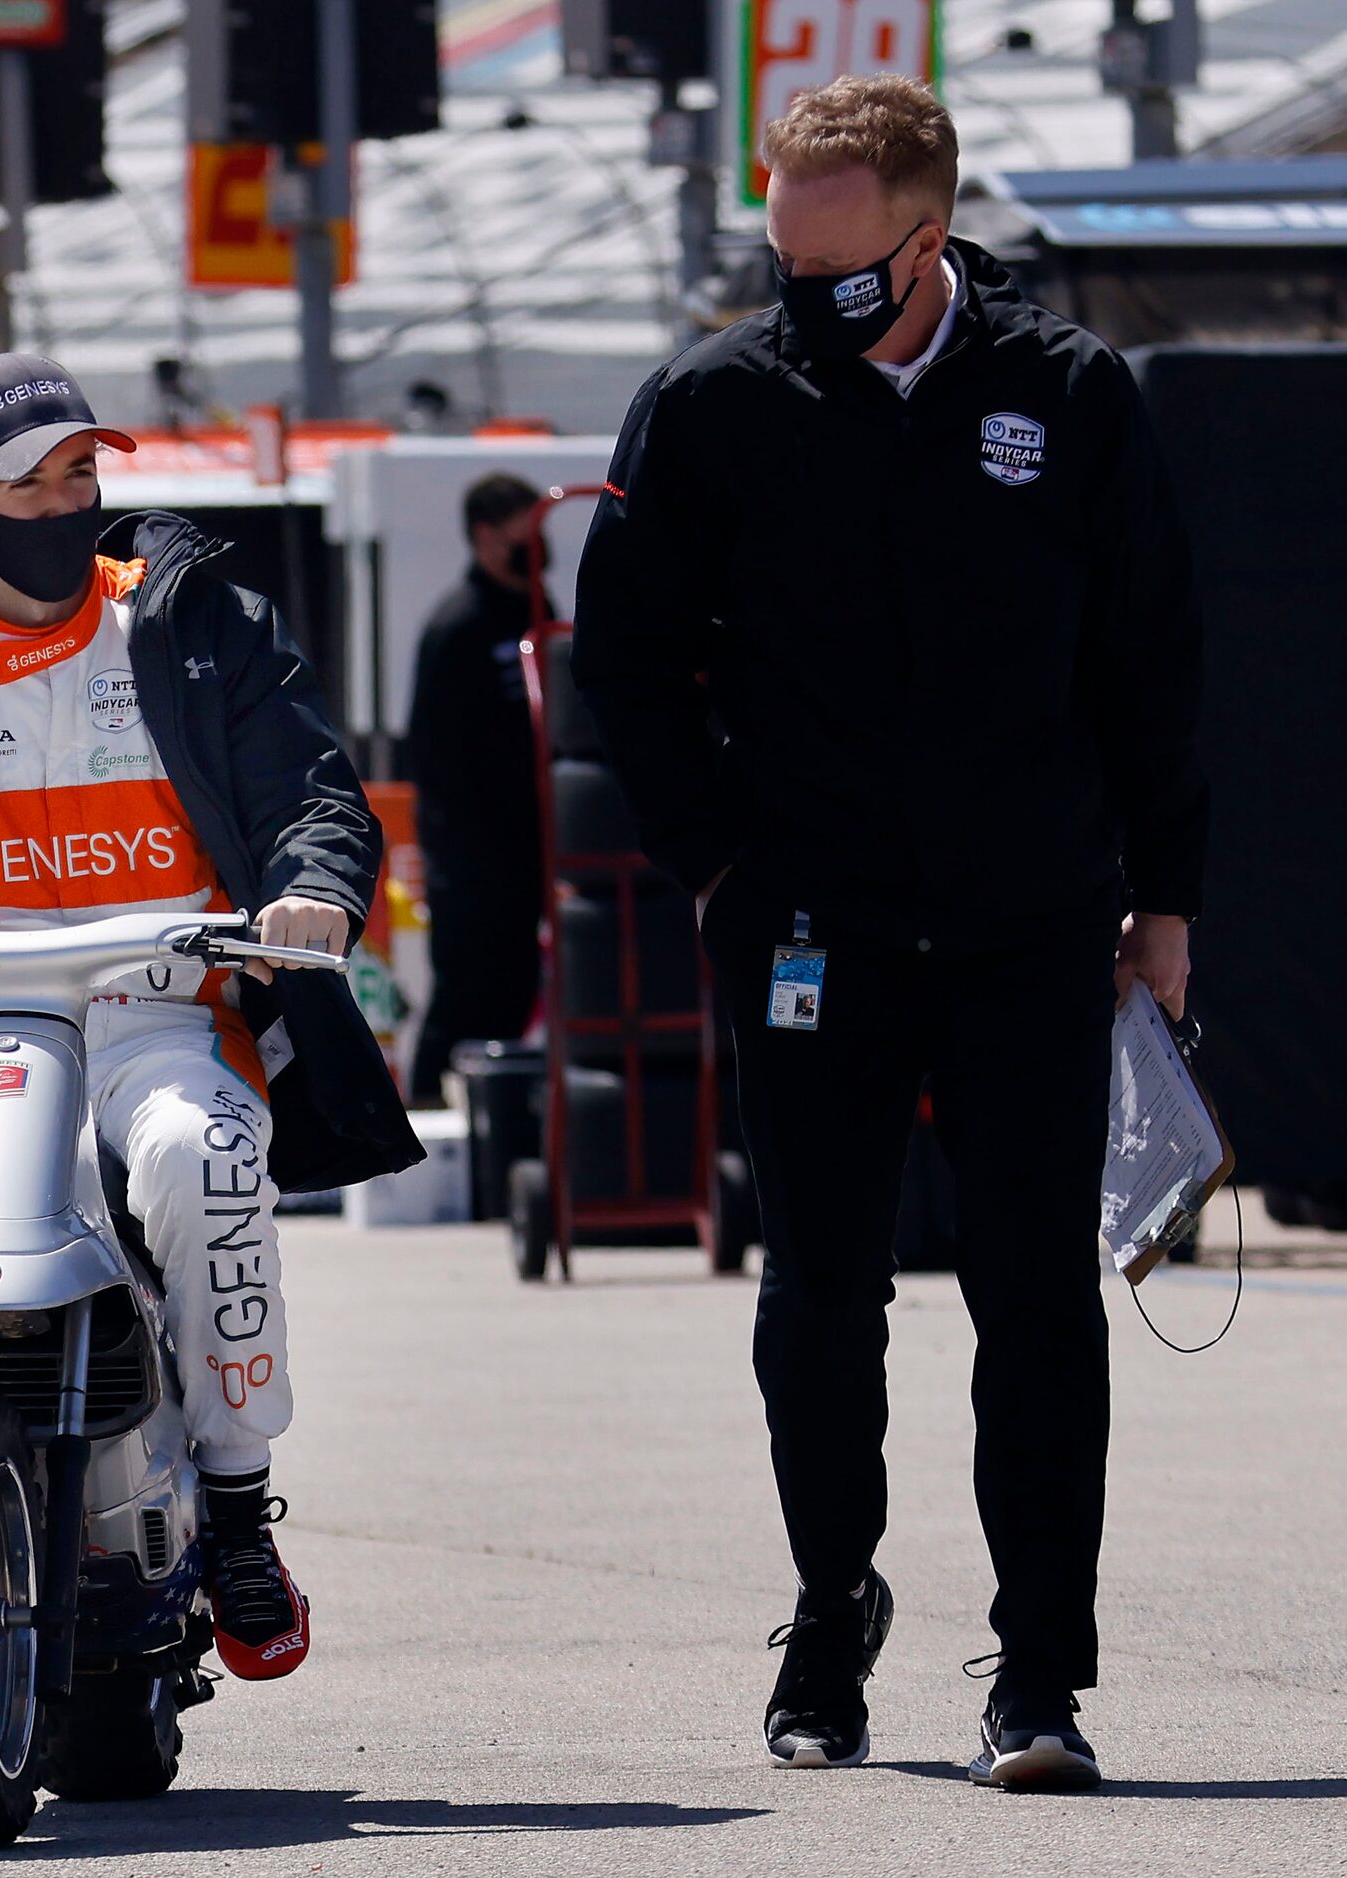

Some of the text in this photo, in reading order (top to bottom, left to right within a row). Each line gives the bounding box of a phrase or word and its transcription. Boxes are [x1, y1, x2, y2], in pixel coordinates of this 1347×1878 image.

[836, 287, 882, 310] INDYCAR
[4, 381, 70, 405] GENESYS
[1008, 427, 1039, 442] NTT
[981, 441, 1042, 462] INDYCAR
[992, 454, 1027, 467] SERIES
[19, 637, 76, 668] GENESYS
[99, 707, 131, 715] SERIES
[95, 754, 150, 768] Capstone
[261, 1636, 304, 1661] STOP
